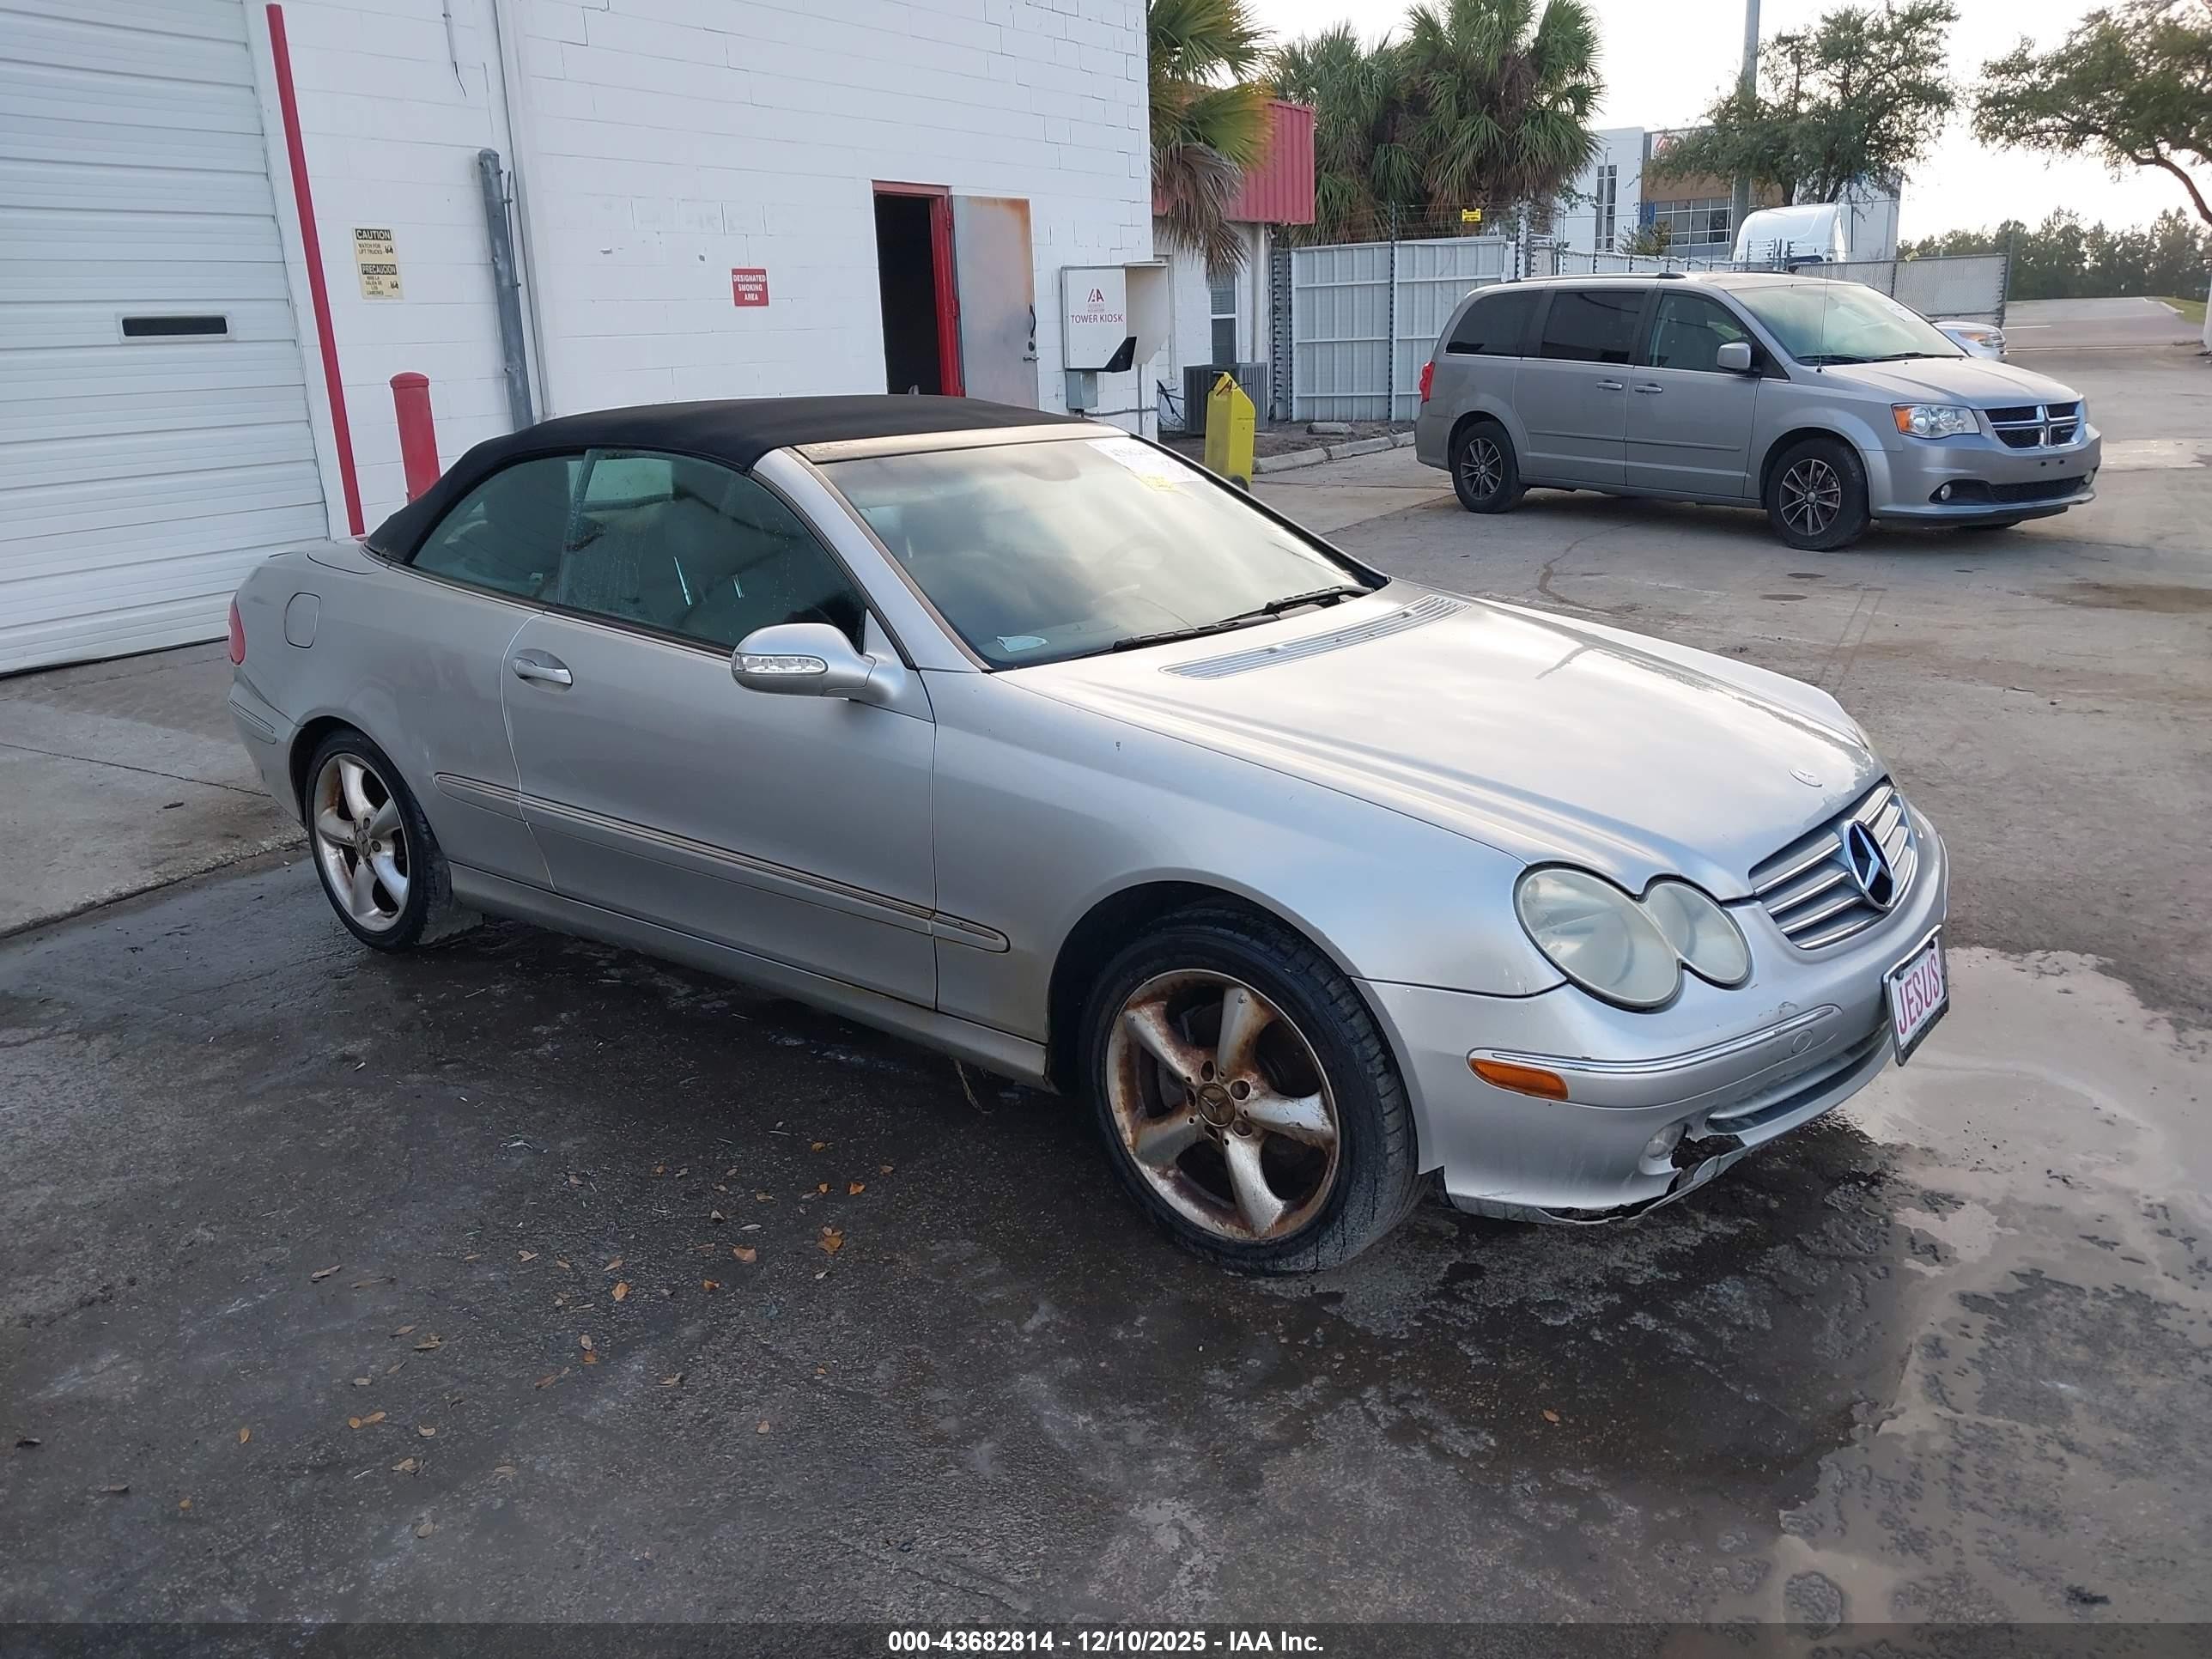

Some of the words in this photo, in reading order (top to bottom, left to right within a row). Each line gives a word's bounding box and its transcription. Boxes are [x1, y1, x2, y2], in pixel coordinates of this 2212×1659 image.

[356, 230, 392, 240] CAUTION
[732, 274, 766, 283] DESIGNATED
[738, 283, 763, 292] SMOKING
[744, 293, 759, 301] AREA
[1071, 314, 1098, 324] TOWER
[1099, 313, 1123, 323] KIOSK
[1899, 953, 1940, 1035] JESUS
